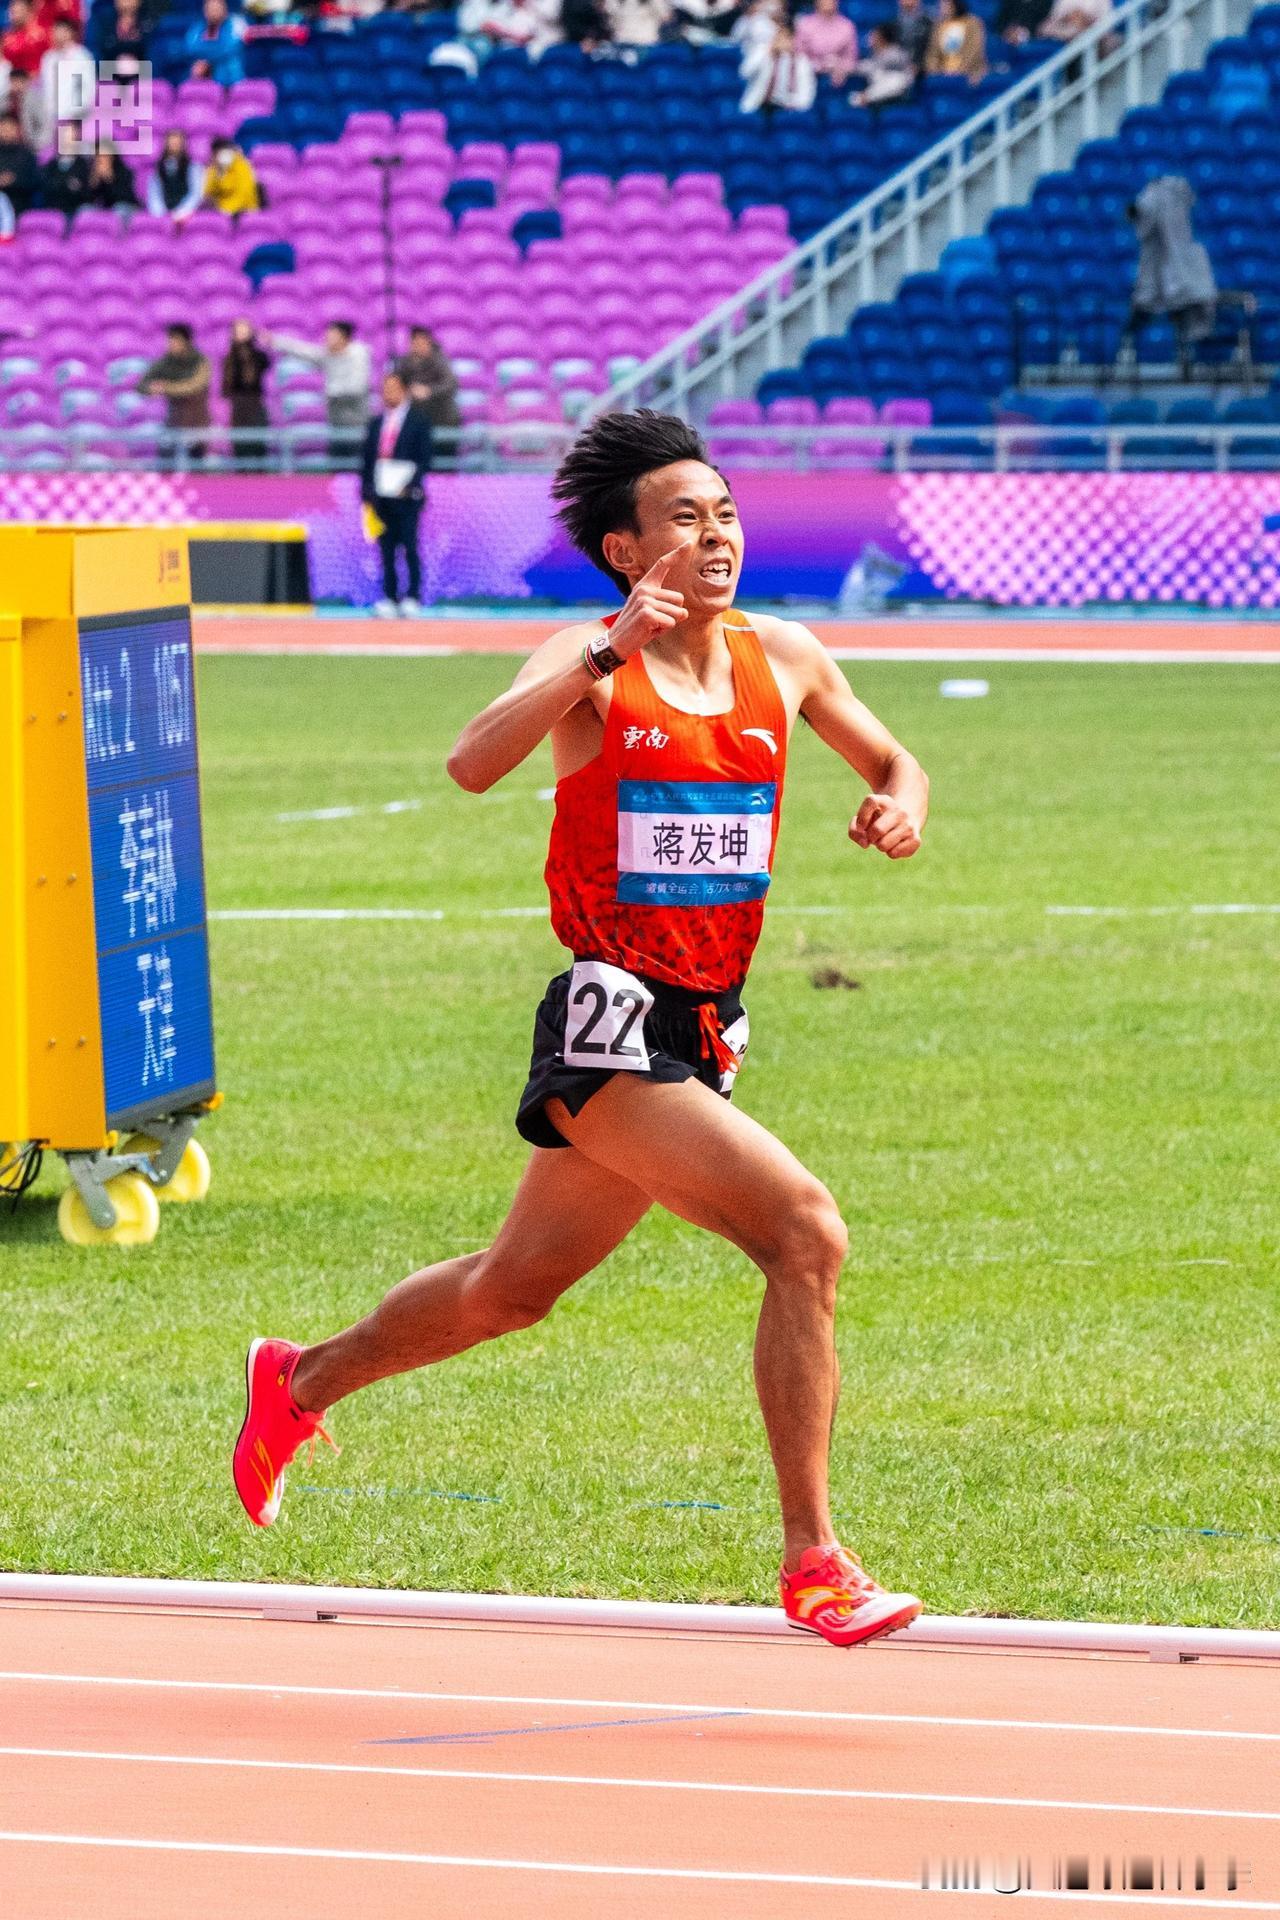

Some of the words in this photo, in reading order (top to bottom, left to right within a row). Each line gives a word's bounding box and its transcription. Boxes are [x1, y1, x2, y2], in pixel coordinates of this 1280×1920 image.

[652, 822, 748, 866] 蒋发坤
[136, 943, 179, 1088] 天津
[570, 982, 645, 1057] 22
